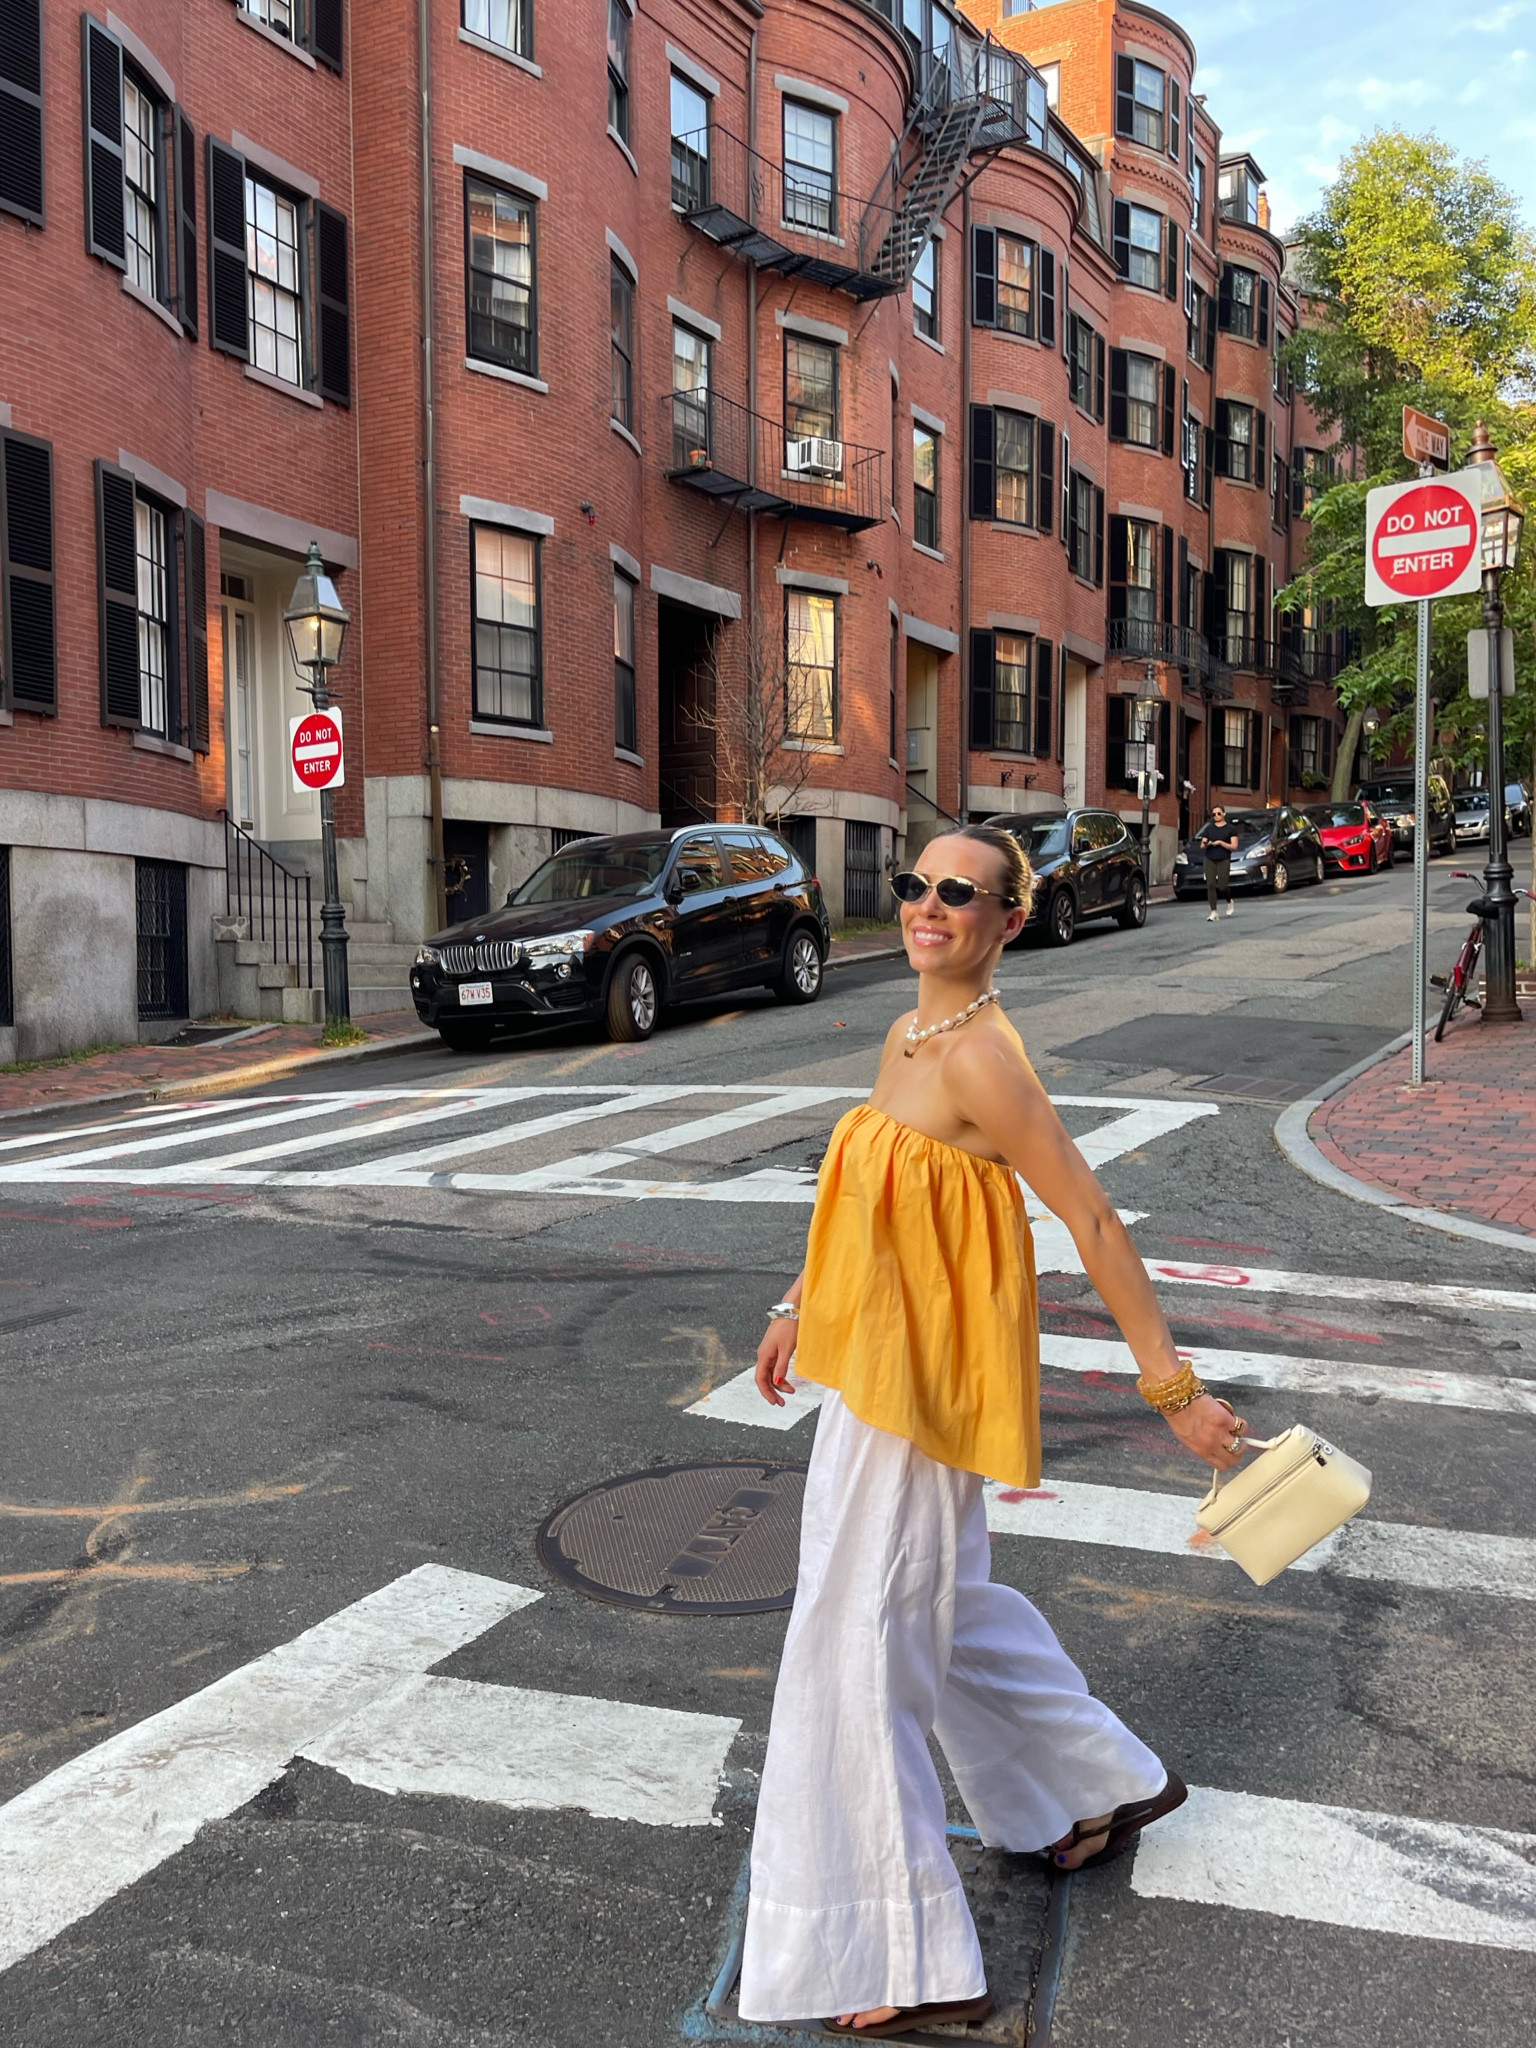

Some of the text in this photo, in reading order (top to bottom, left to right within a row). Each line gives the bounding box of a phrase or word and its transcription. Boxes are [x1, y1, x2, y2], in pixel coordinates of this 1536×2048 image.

[1417, 428, 1445, 457] ONE WAY
[1387, 506, 1463, 533] DO NOT
[1393, 552, 1454, 575] ENTER
[300, 728, 332, 743] DO NOT
[303, 760, 331, 775] ENTER
